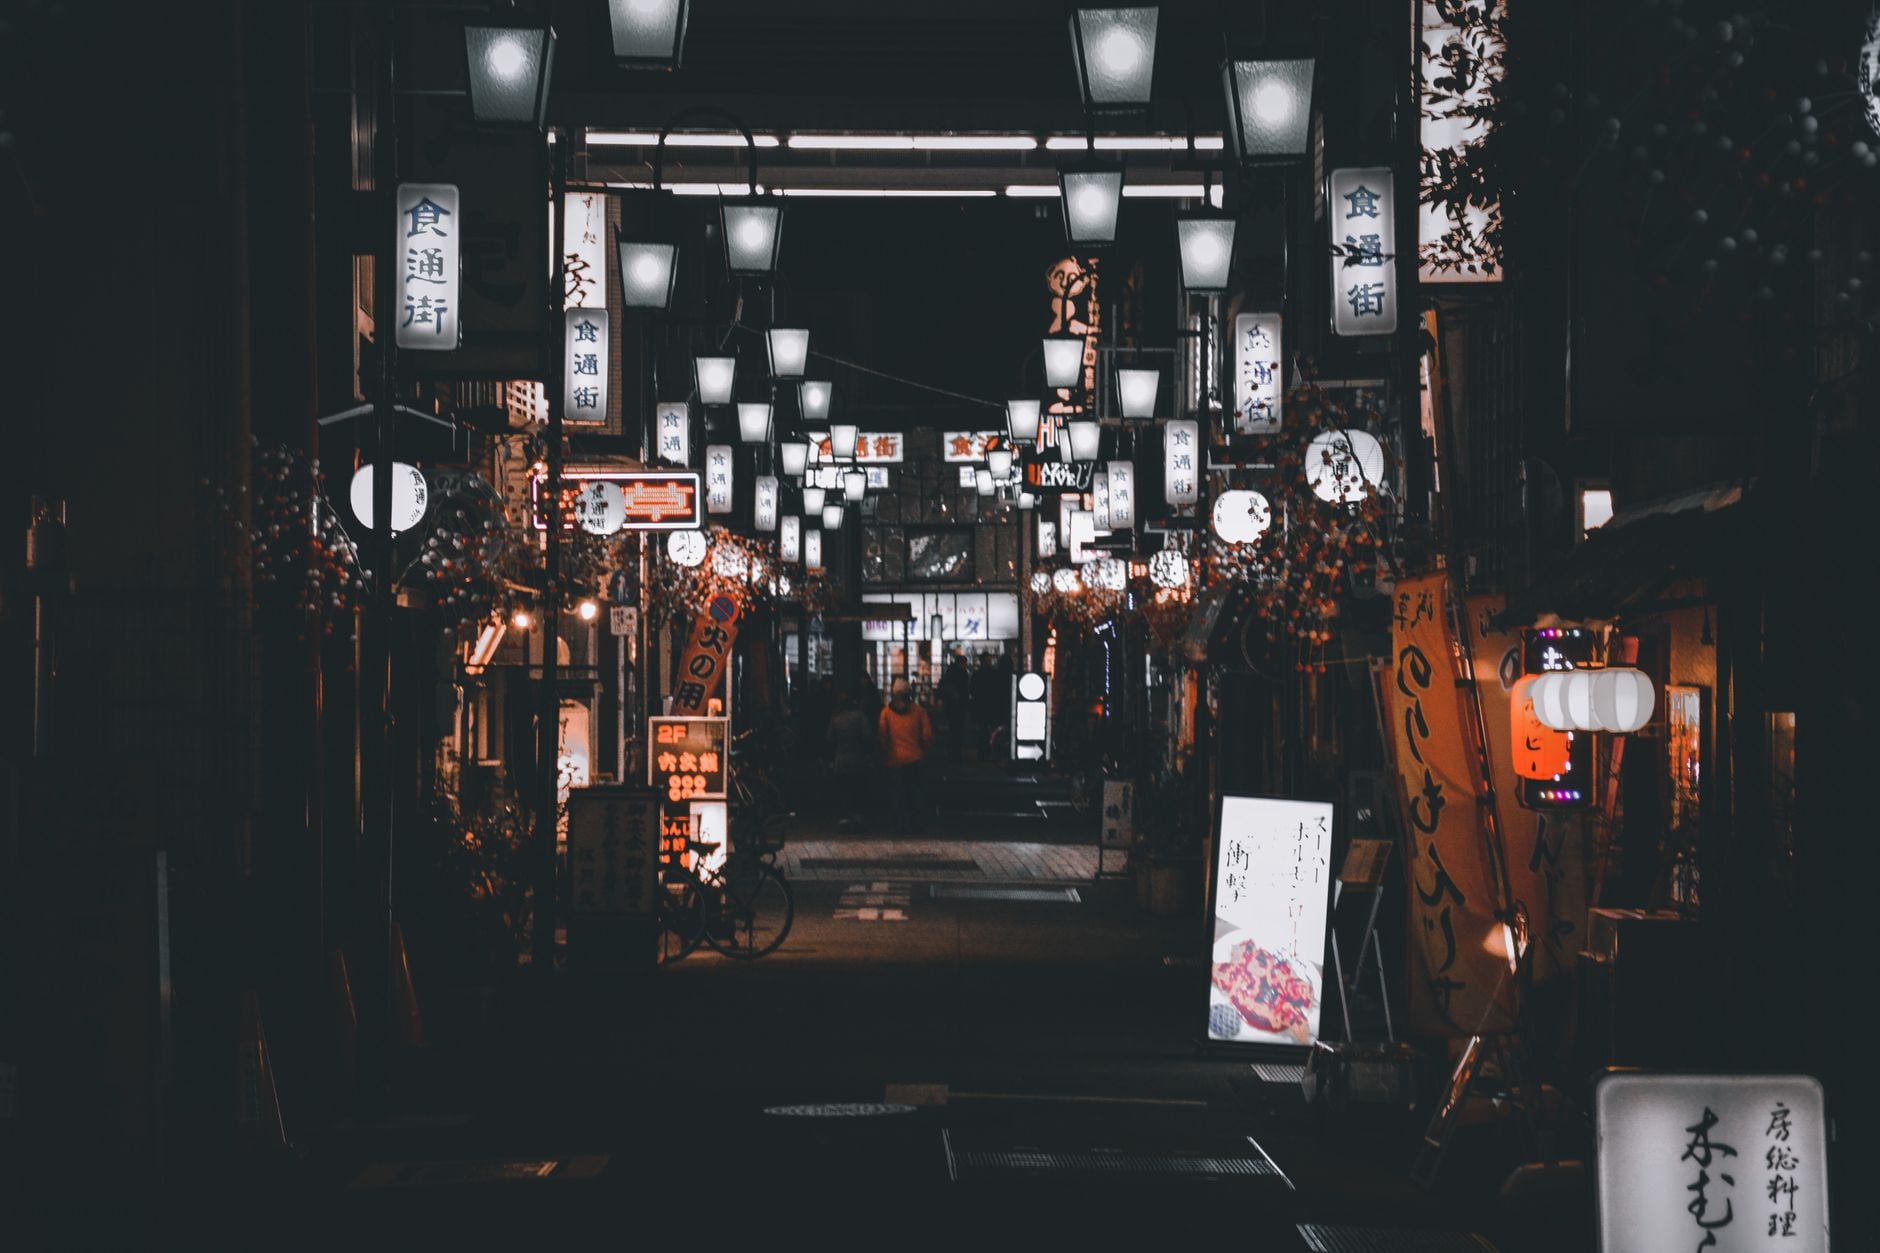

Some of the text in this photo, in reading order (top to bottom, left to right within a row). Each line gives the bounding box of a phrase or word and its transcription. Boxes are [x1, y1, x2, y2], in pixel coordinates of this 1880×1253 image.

[402, 196, 451, 335] 食通街
[1343, 185, 1386, 318] 食通街
[573, 319, 600, 410] 食通街
[1172, 429, 1193, 496] 食通街
[657, 724, 687, 744] 2F
[1766, 1102, 1799, 1237] 房総料理
